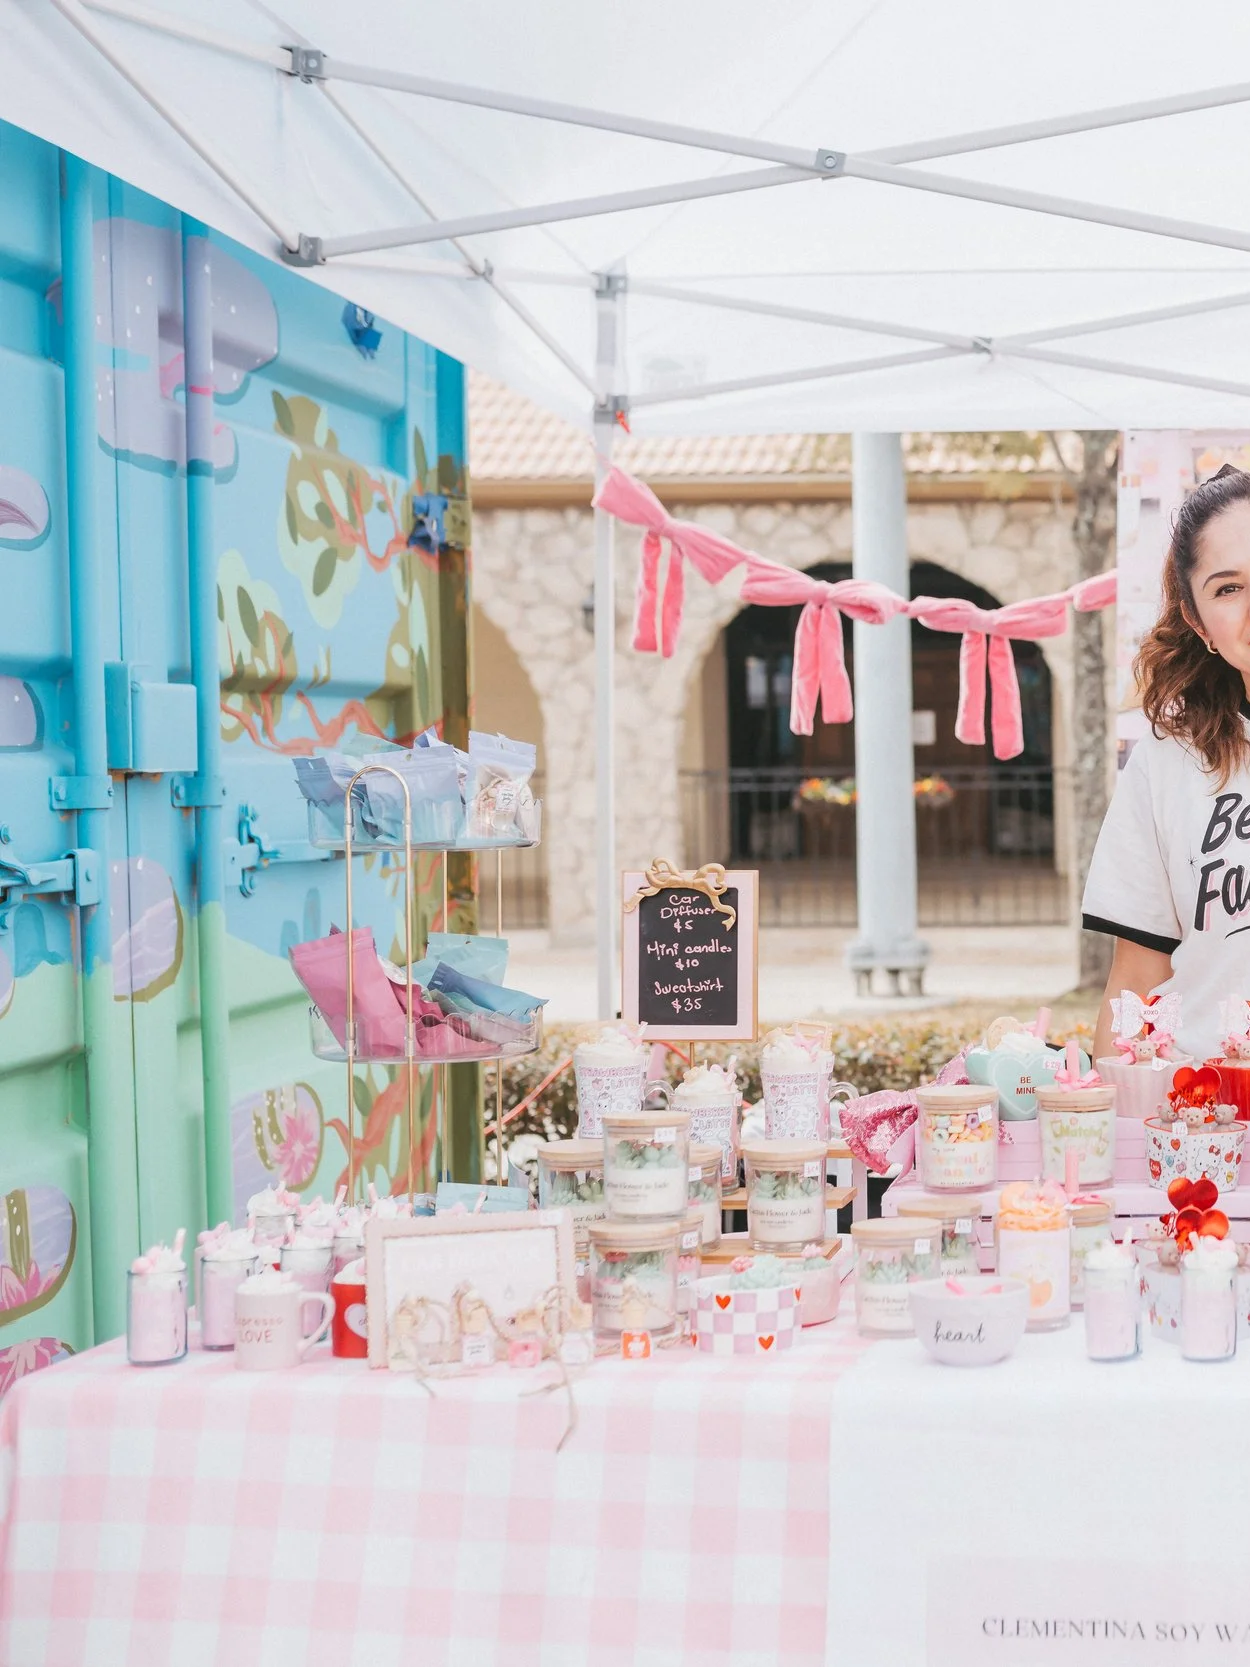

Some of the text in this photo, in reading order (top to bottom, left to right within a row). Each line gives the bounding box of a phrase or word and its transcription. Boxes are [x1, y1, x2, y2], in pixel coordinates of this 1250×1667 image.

[669, 894, 700, 906] Car
[660, 906, 716, 919] Diffuser
[673, 919, 694, 933] $5
[647, 938, 733, 961] Mini candles
[675, 958, 700, 971] $10
[654, 978, 724, 996] Sweatshirt
[671, 998, 703, 1014] $35
[1020, 1076, 1031, 1084] BE
[1016, 1087, 1036, 1095] MINE
[239, 1329, 272, 1344] LOVE
[933, 1319, 985, 1344] heart
[981, 1617, 1146, 1641] CLEMENTINA
[1155, 1622, 1206, 1643] SOY
